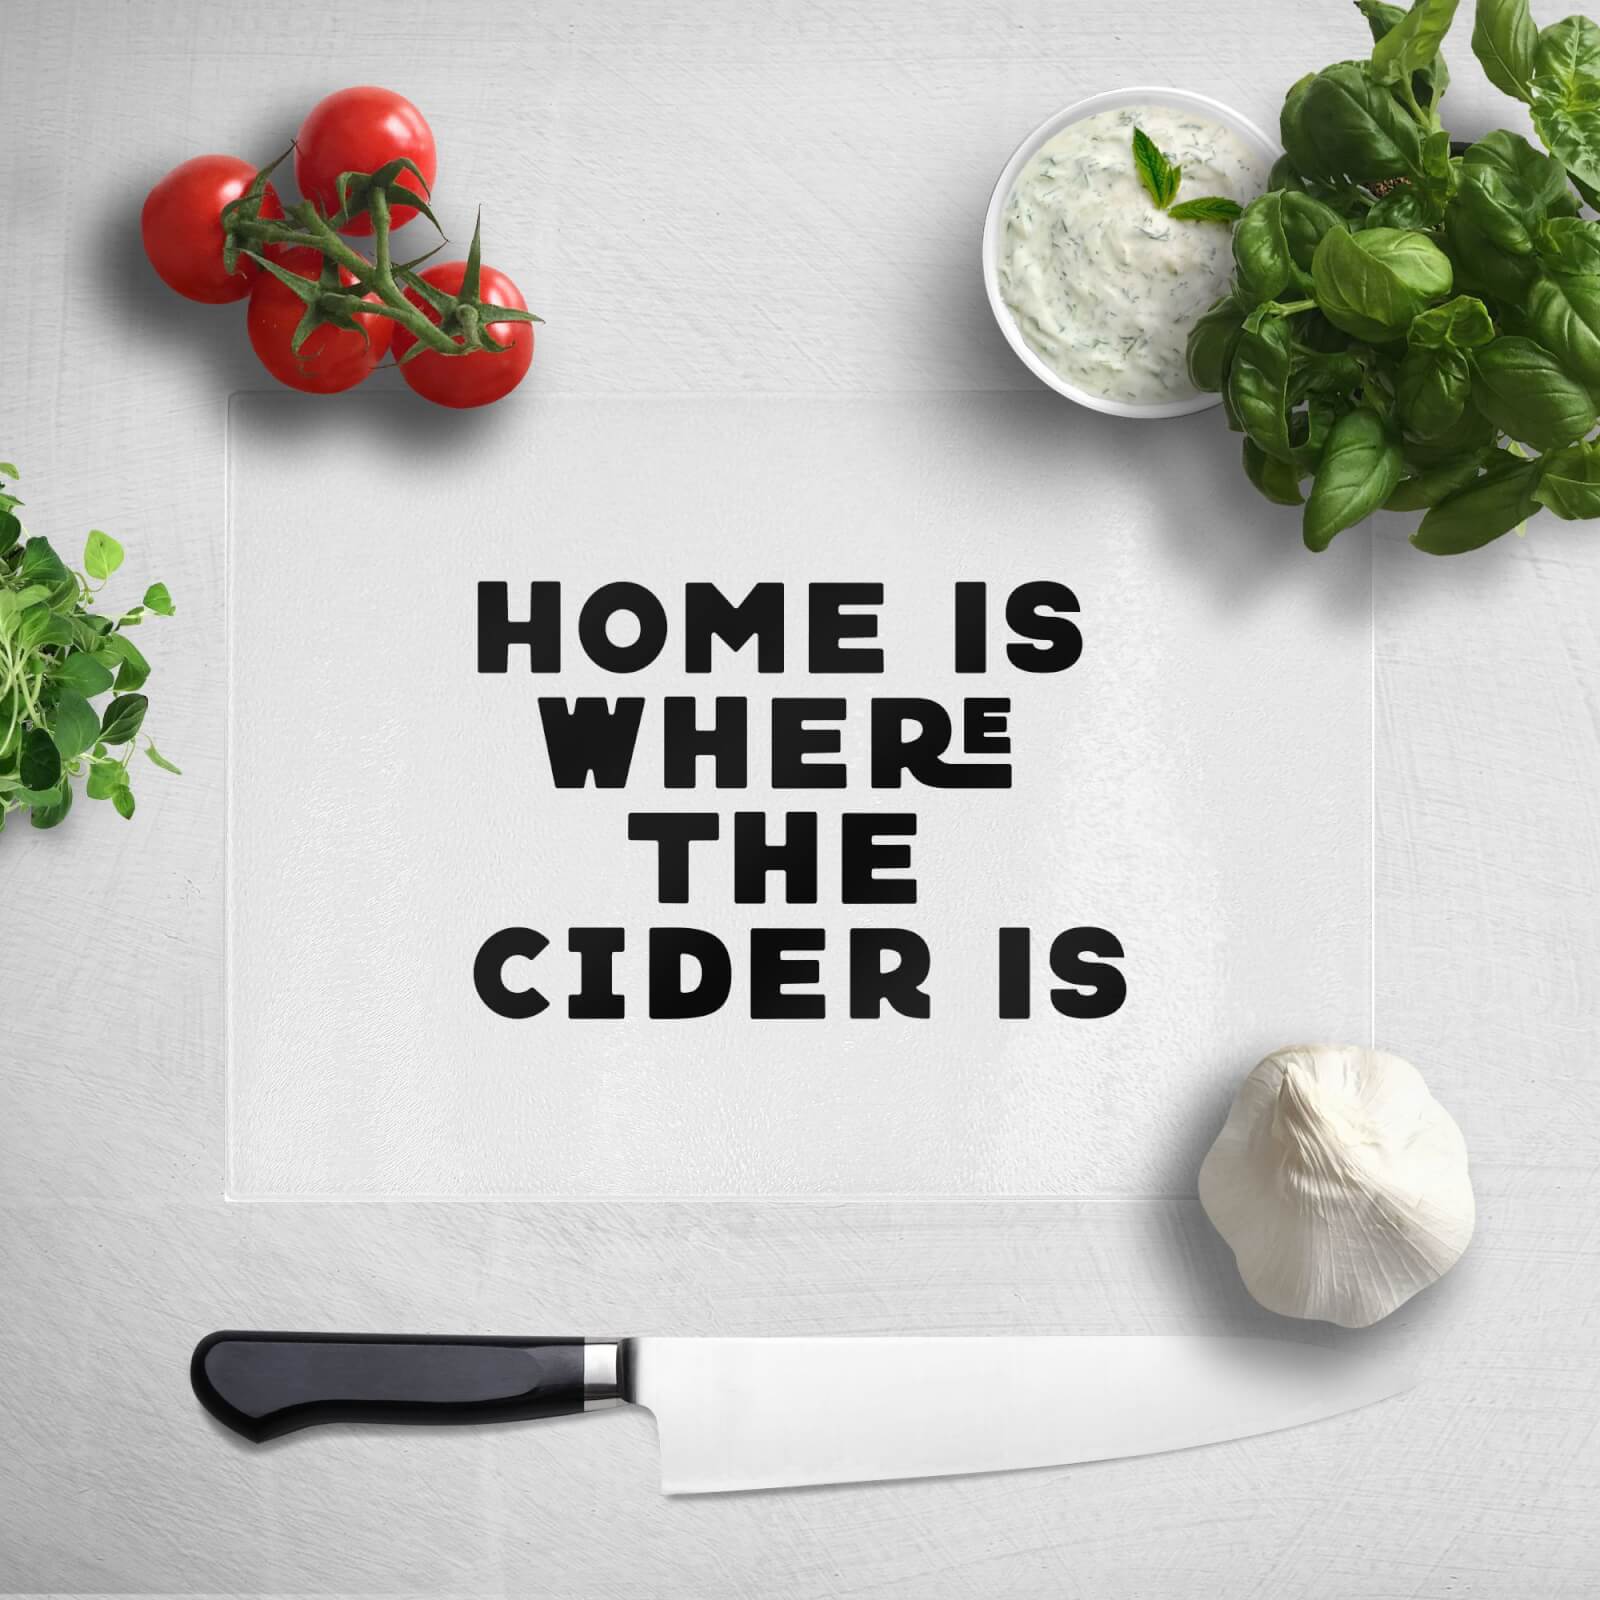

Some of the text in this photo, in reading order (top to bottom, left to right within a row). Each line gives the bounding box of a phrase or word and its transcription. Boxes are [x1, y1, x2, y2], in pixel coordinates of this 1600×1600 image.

[478, 580, 1083, 674] HOME IS
[538, 696, 1013, 789] WHERE
[628, 811, 918, 905] THE
[473, 926, 1127, 1020] CIDER IS
